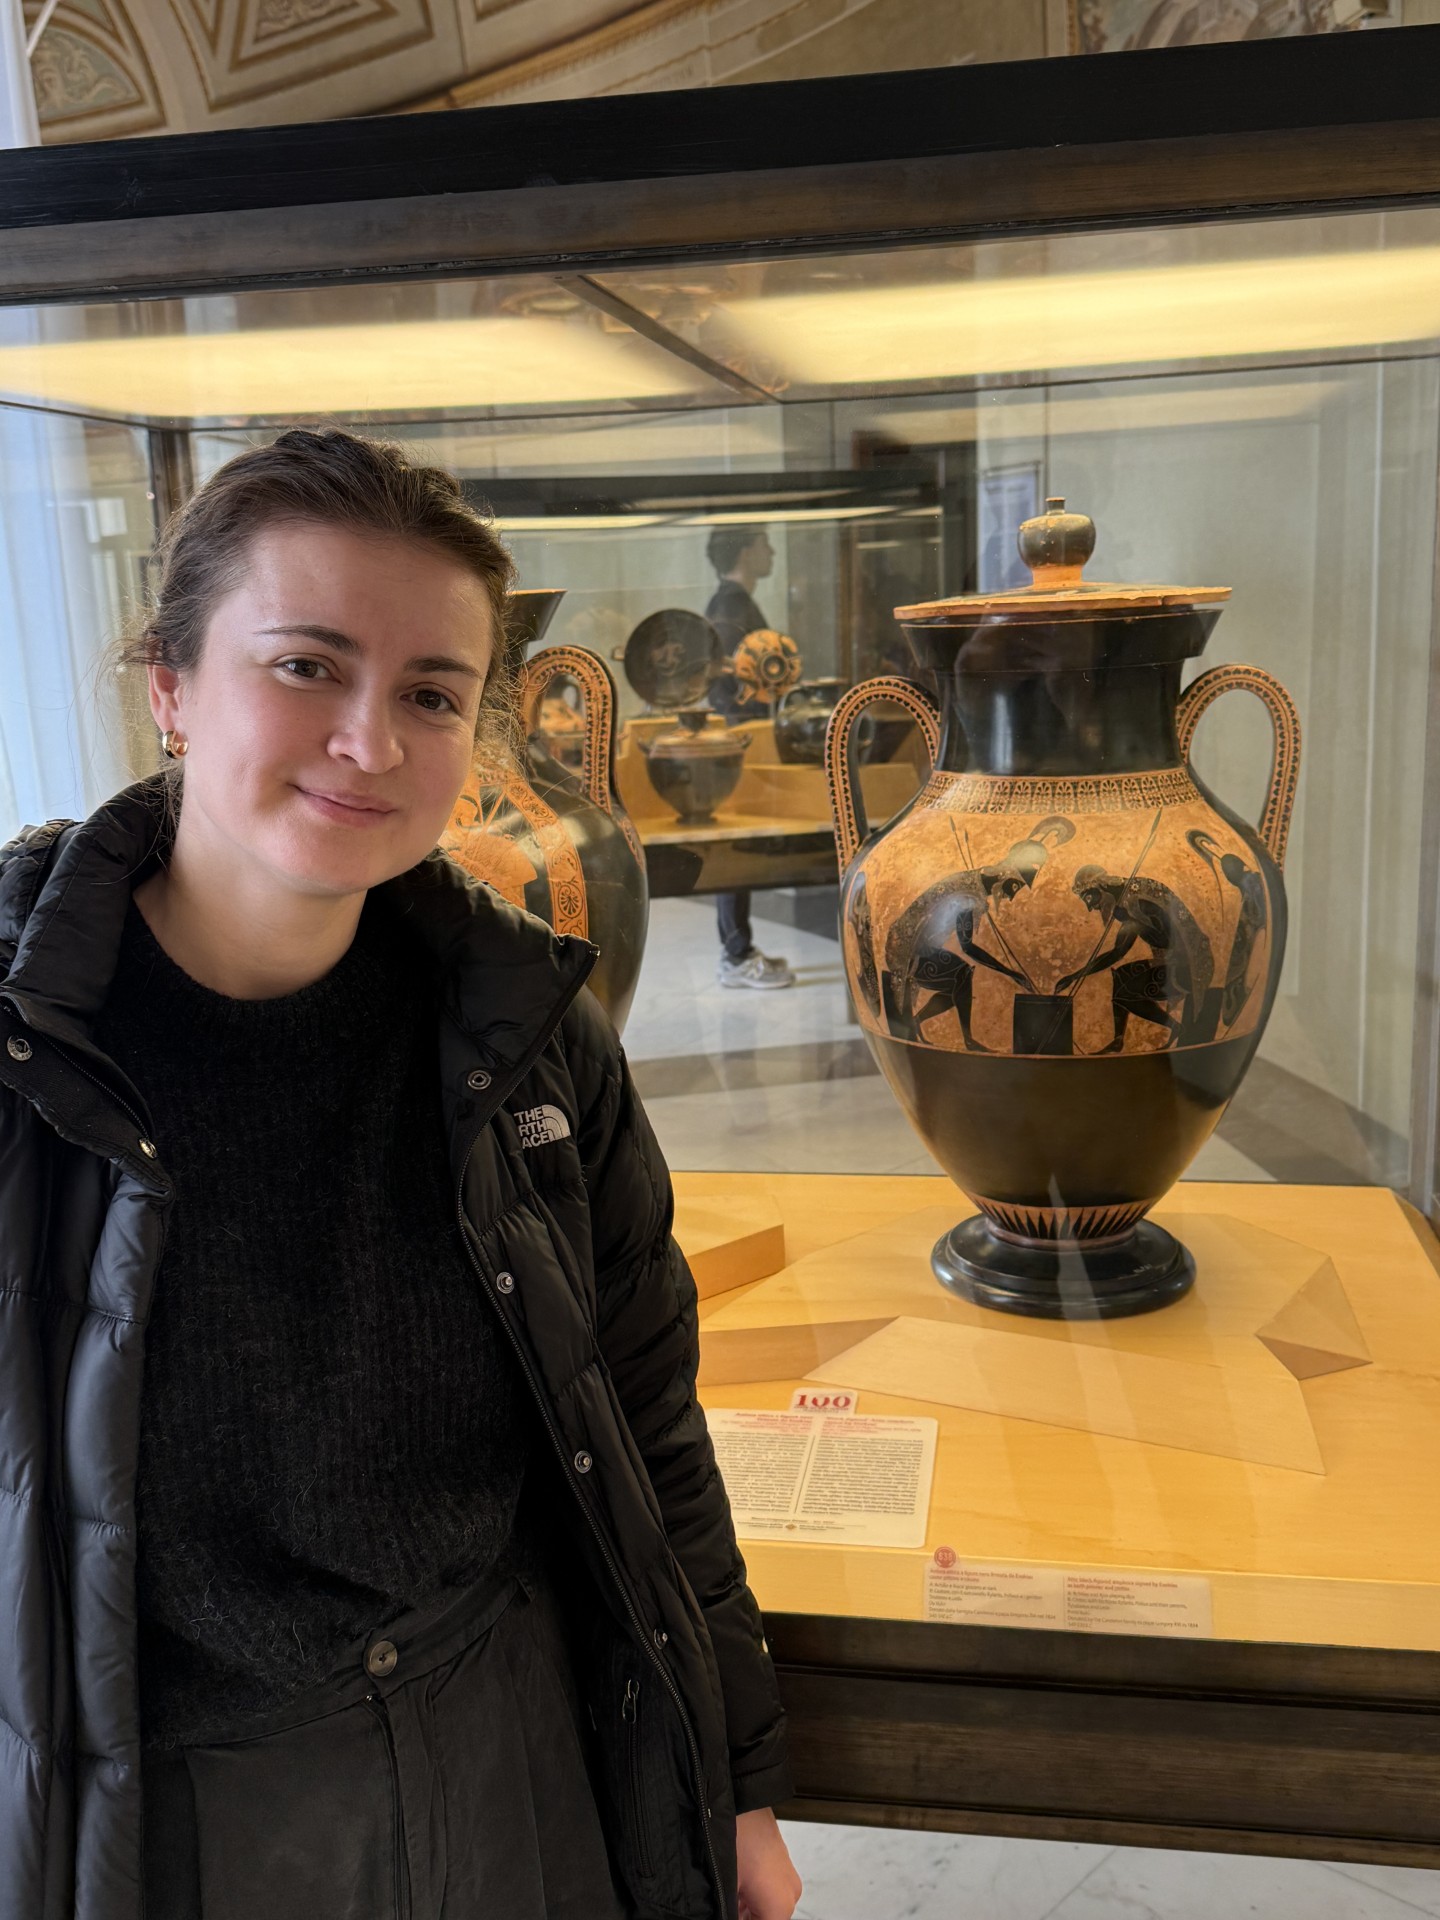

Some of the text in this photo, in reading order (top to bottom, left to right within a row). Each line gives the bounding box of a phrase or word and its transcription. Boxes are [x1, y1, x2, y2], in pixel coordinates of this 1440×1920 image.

[514, 1106, 544, 1124] THE
[518, 1119, 548, 1137] RTH
[522, 1131, 550, 1149] ACE
[797, 1394, 851, 1408] 100
